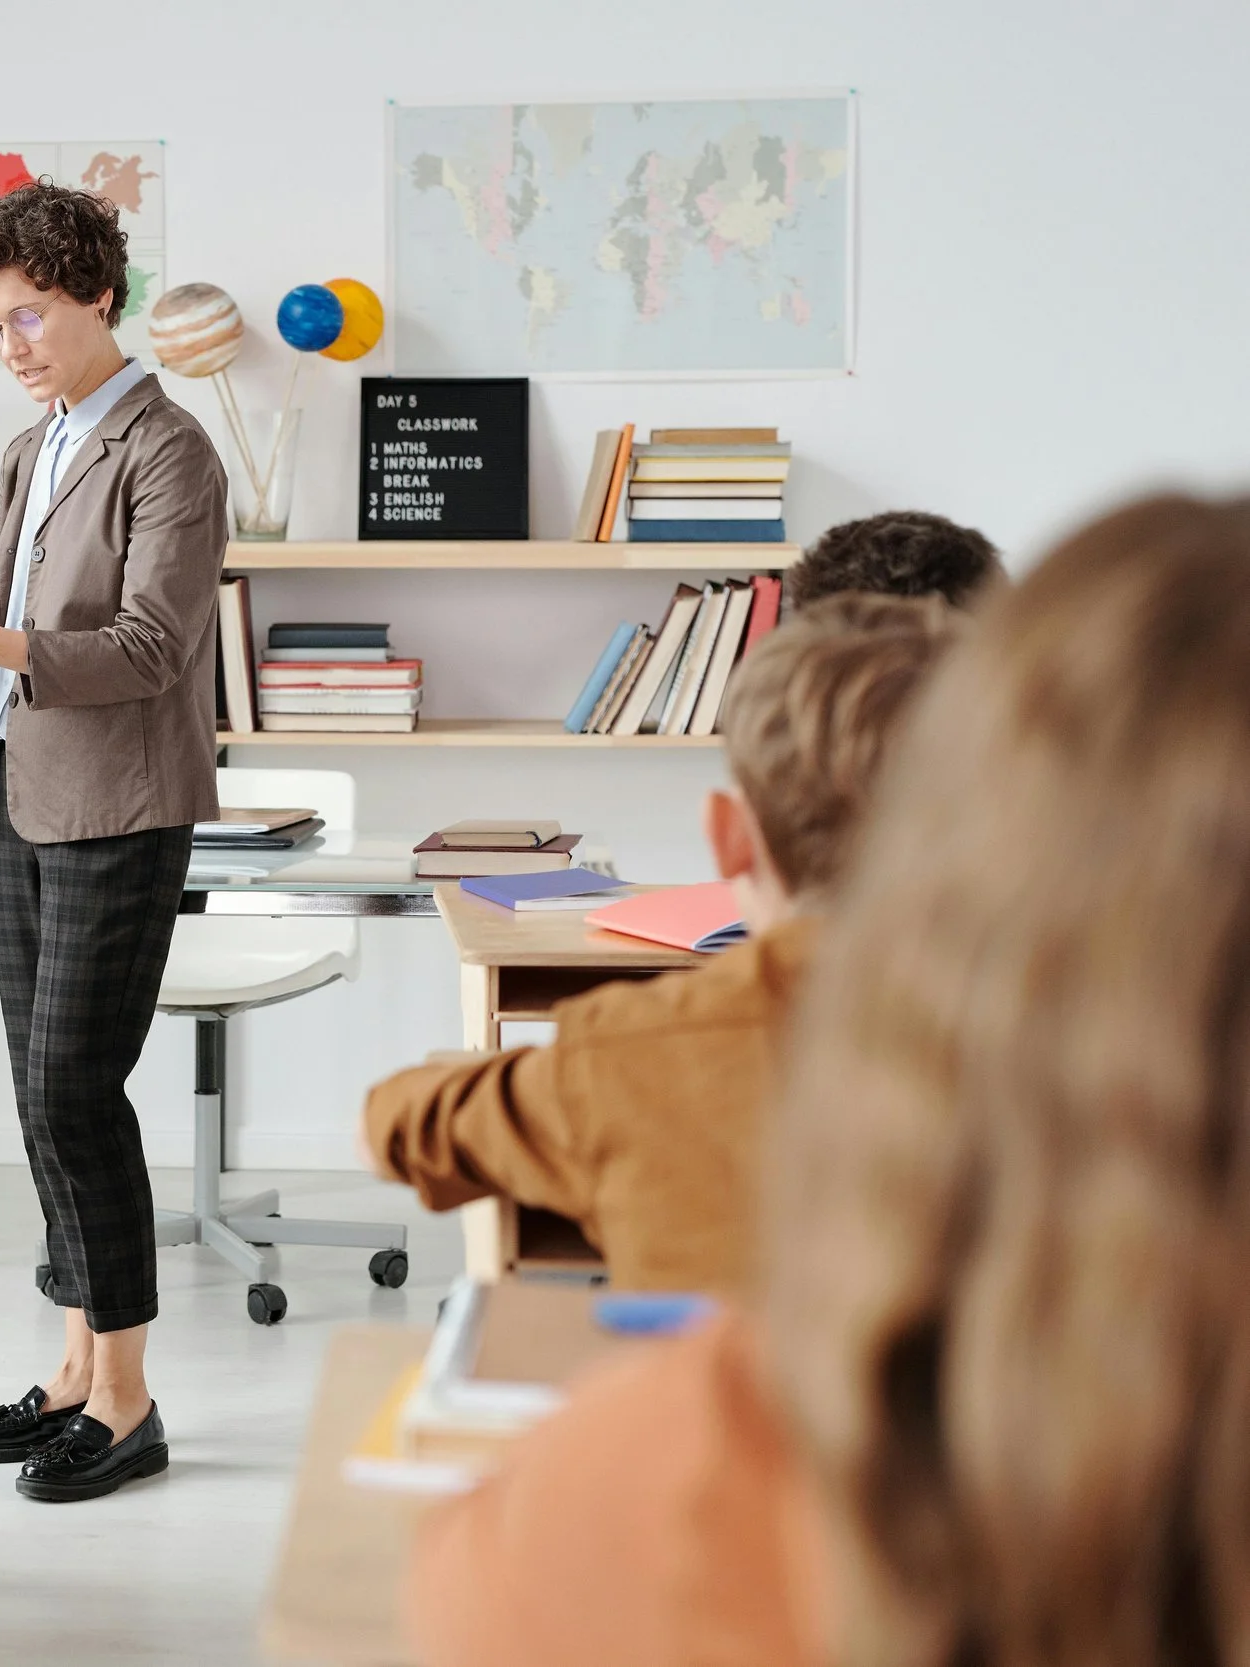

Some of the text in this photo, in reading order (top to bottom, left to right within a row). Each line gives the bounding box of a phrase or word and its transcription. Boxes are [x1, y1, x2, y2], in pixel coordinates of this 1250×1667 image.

[377, 395, 418, 408] DAY 5
[397, 418, 478, 431] CLASSWORK
[370, 442, 428, 455] 1 MATHS
[369, 456, 483, 470] 2 INFORMATICS
[383, 474, 430, 488] BREAK
[369, 492, 445, 506] 3 ENGLISH
[368, 507, 442, 521] 4 SCIENCE
